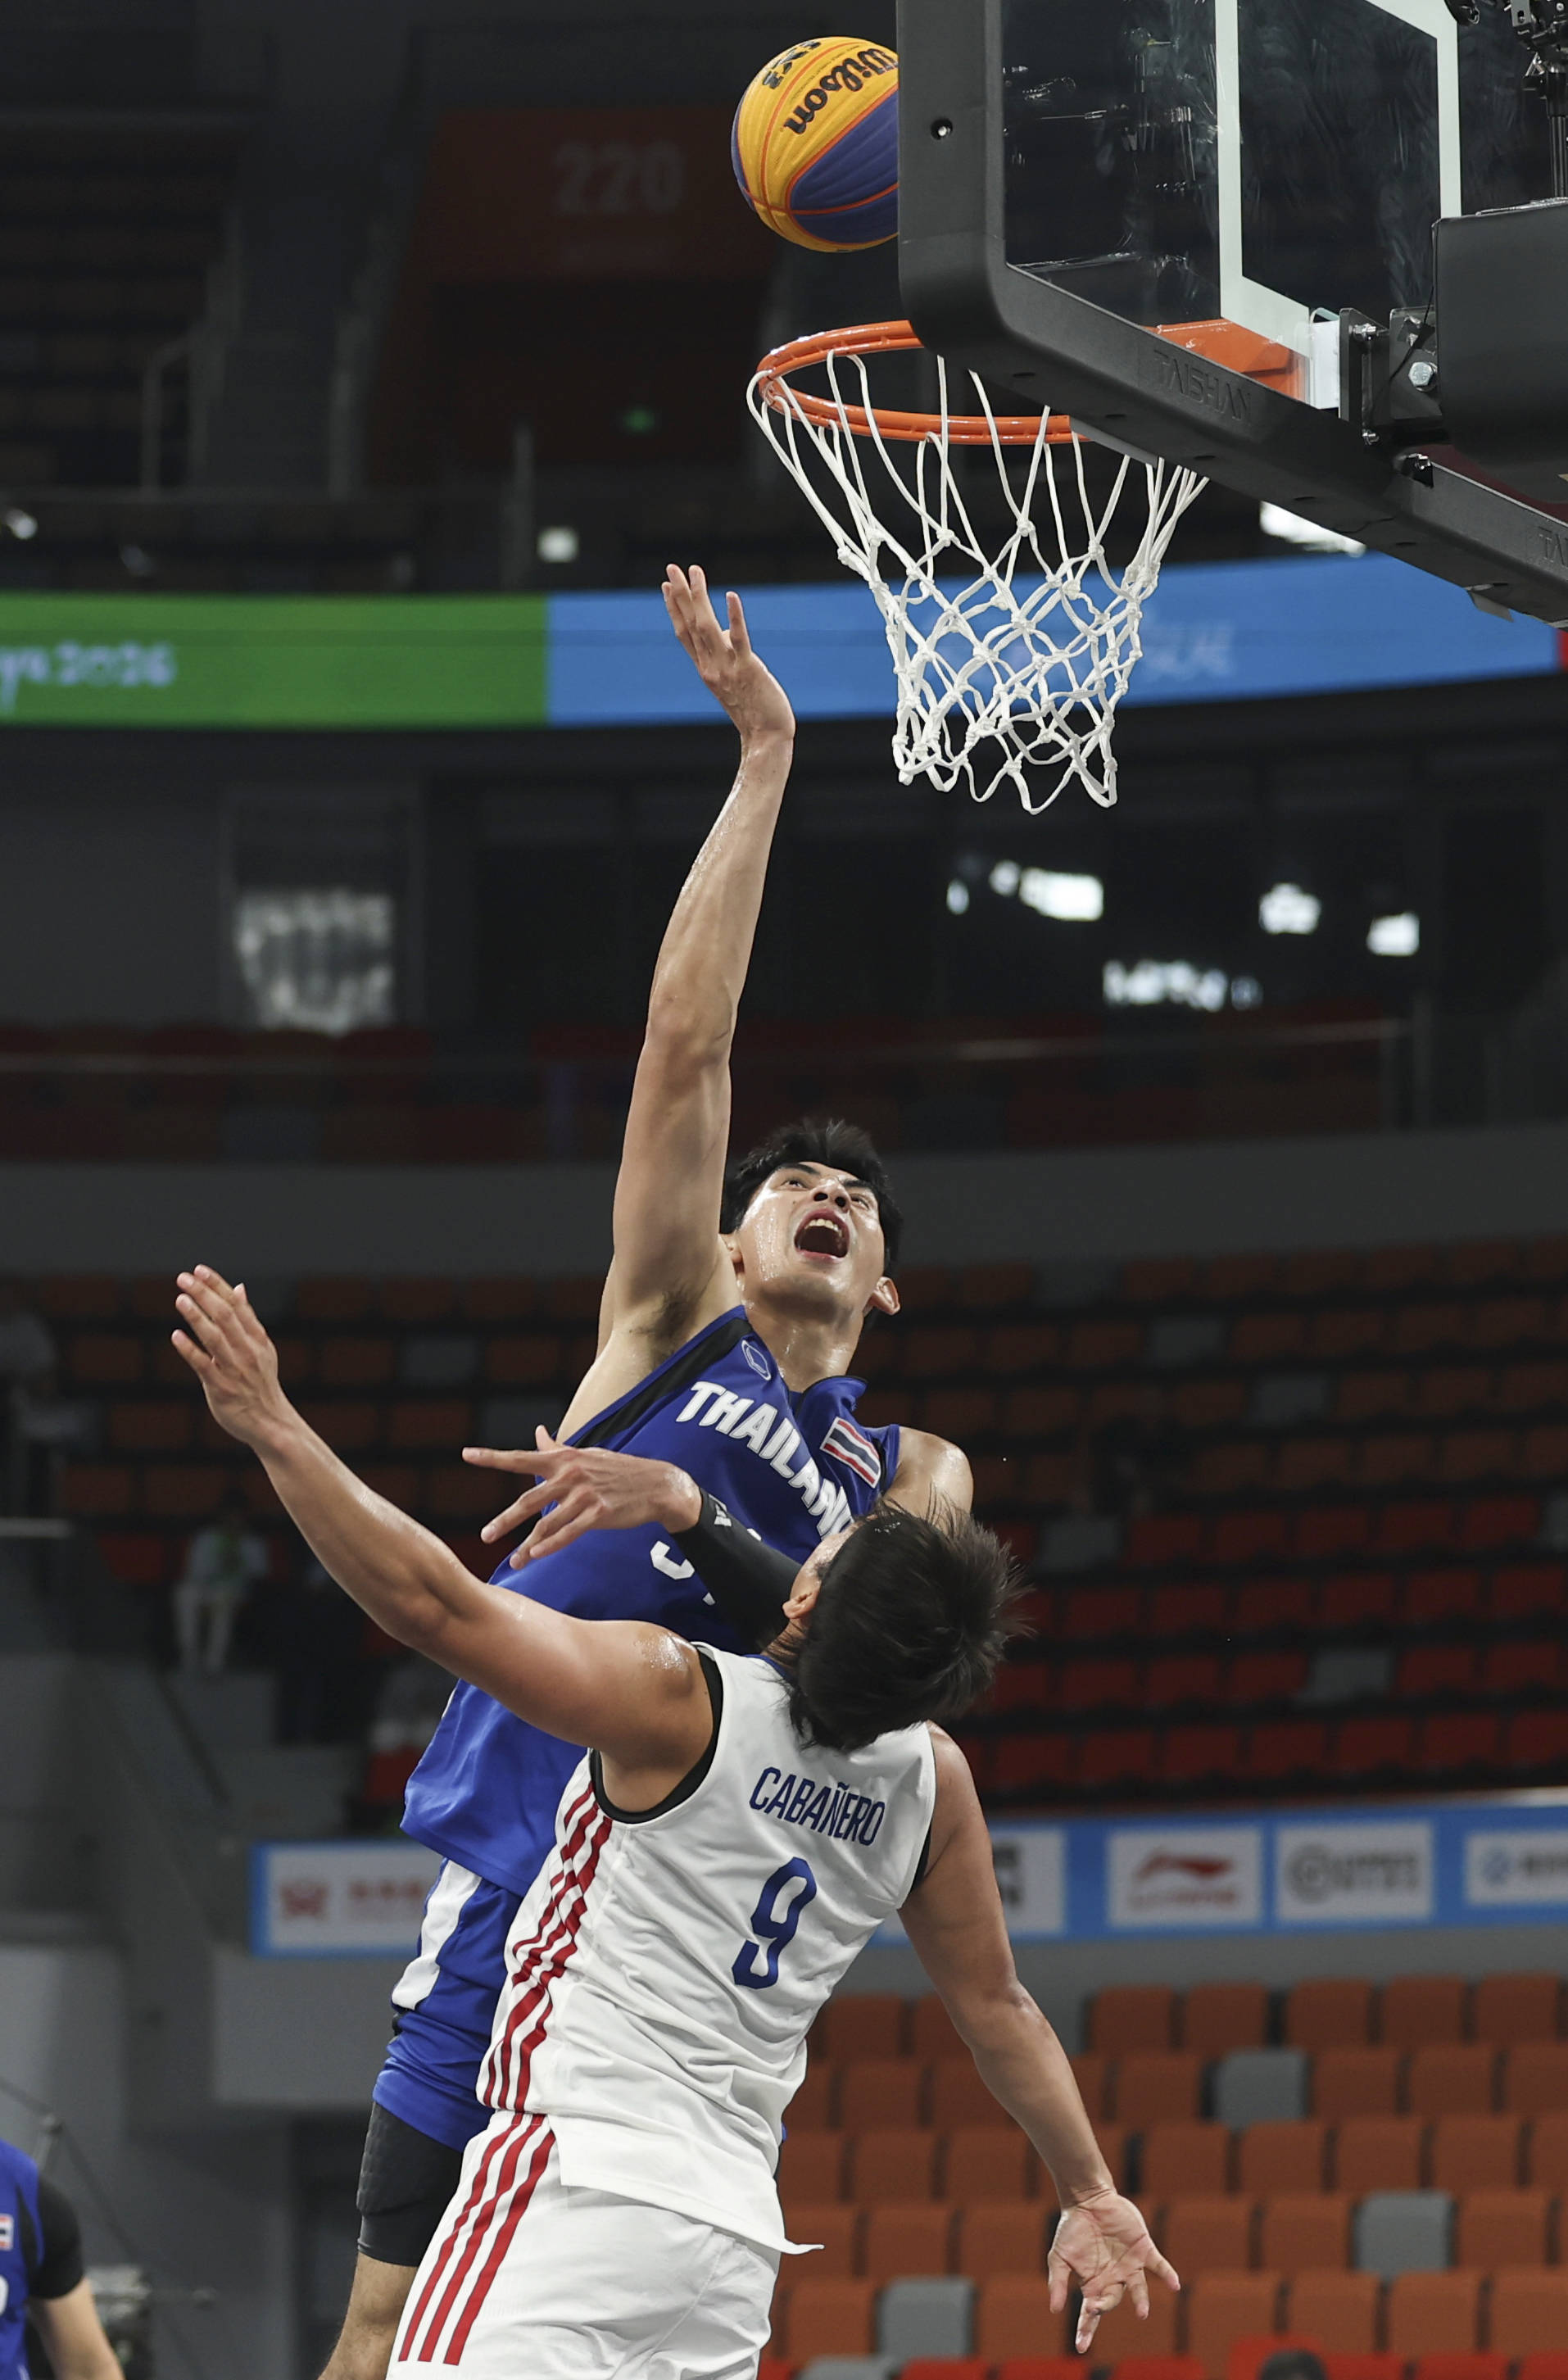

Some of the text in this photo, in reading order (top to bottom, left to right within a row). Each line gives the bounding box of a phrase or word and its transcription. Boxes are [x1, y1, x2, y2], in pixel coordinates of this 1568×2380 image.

[783, 48, 899, 135] Wilson
[553, 139, 686, 215] 220
[749, 1766, 886, 1847] CABAÑERO
[732, 1856, 818, 1990] 9
